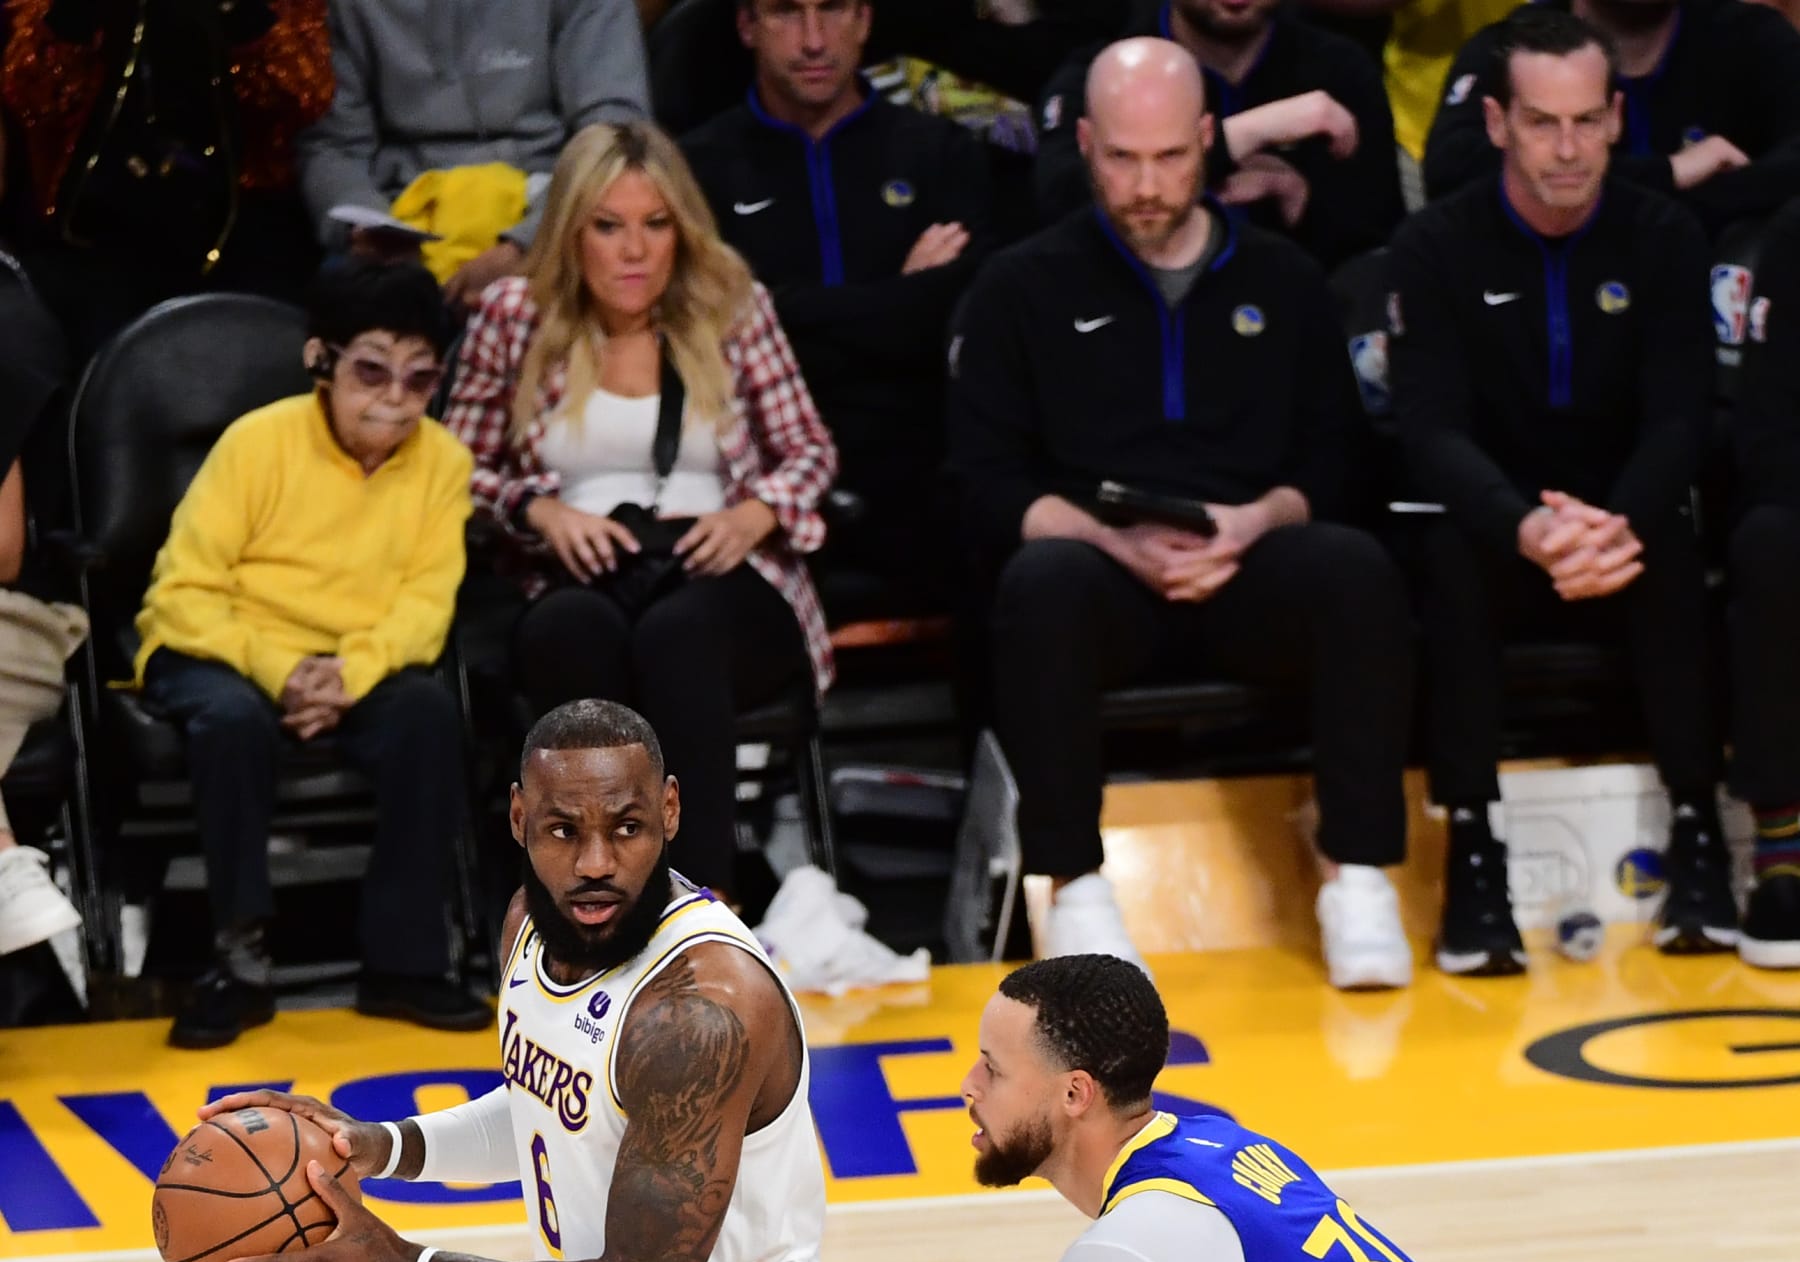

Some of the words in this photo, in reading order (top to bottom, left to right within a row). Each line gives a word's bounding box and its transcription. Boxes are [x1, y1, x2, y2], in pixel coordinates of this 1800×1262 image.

[501, 1007, 593, 1136] LAKERS
[573, 1012, 606, 1044] bibigo
[530, 1129, 565, 1261] 6
